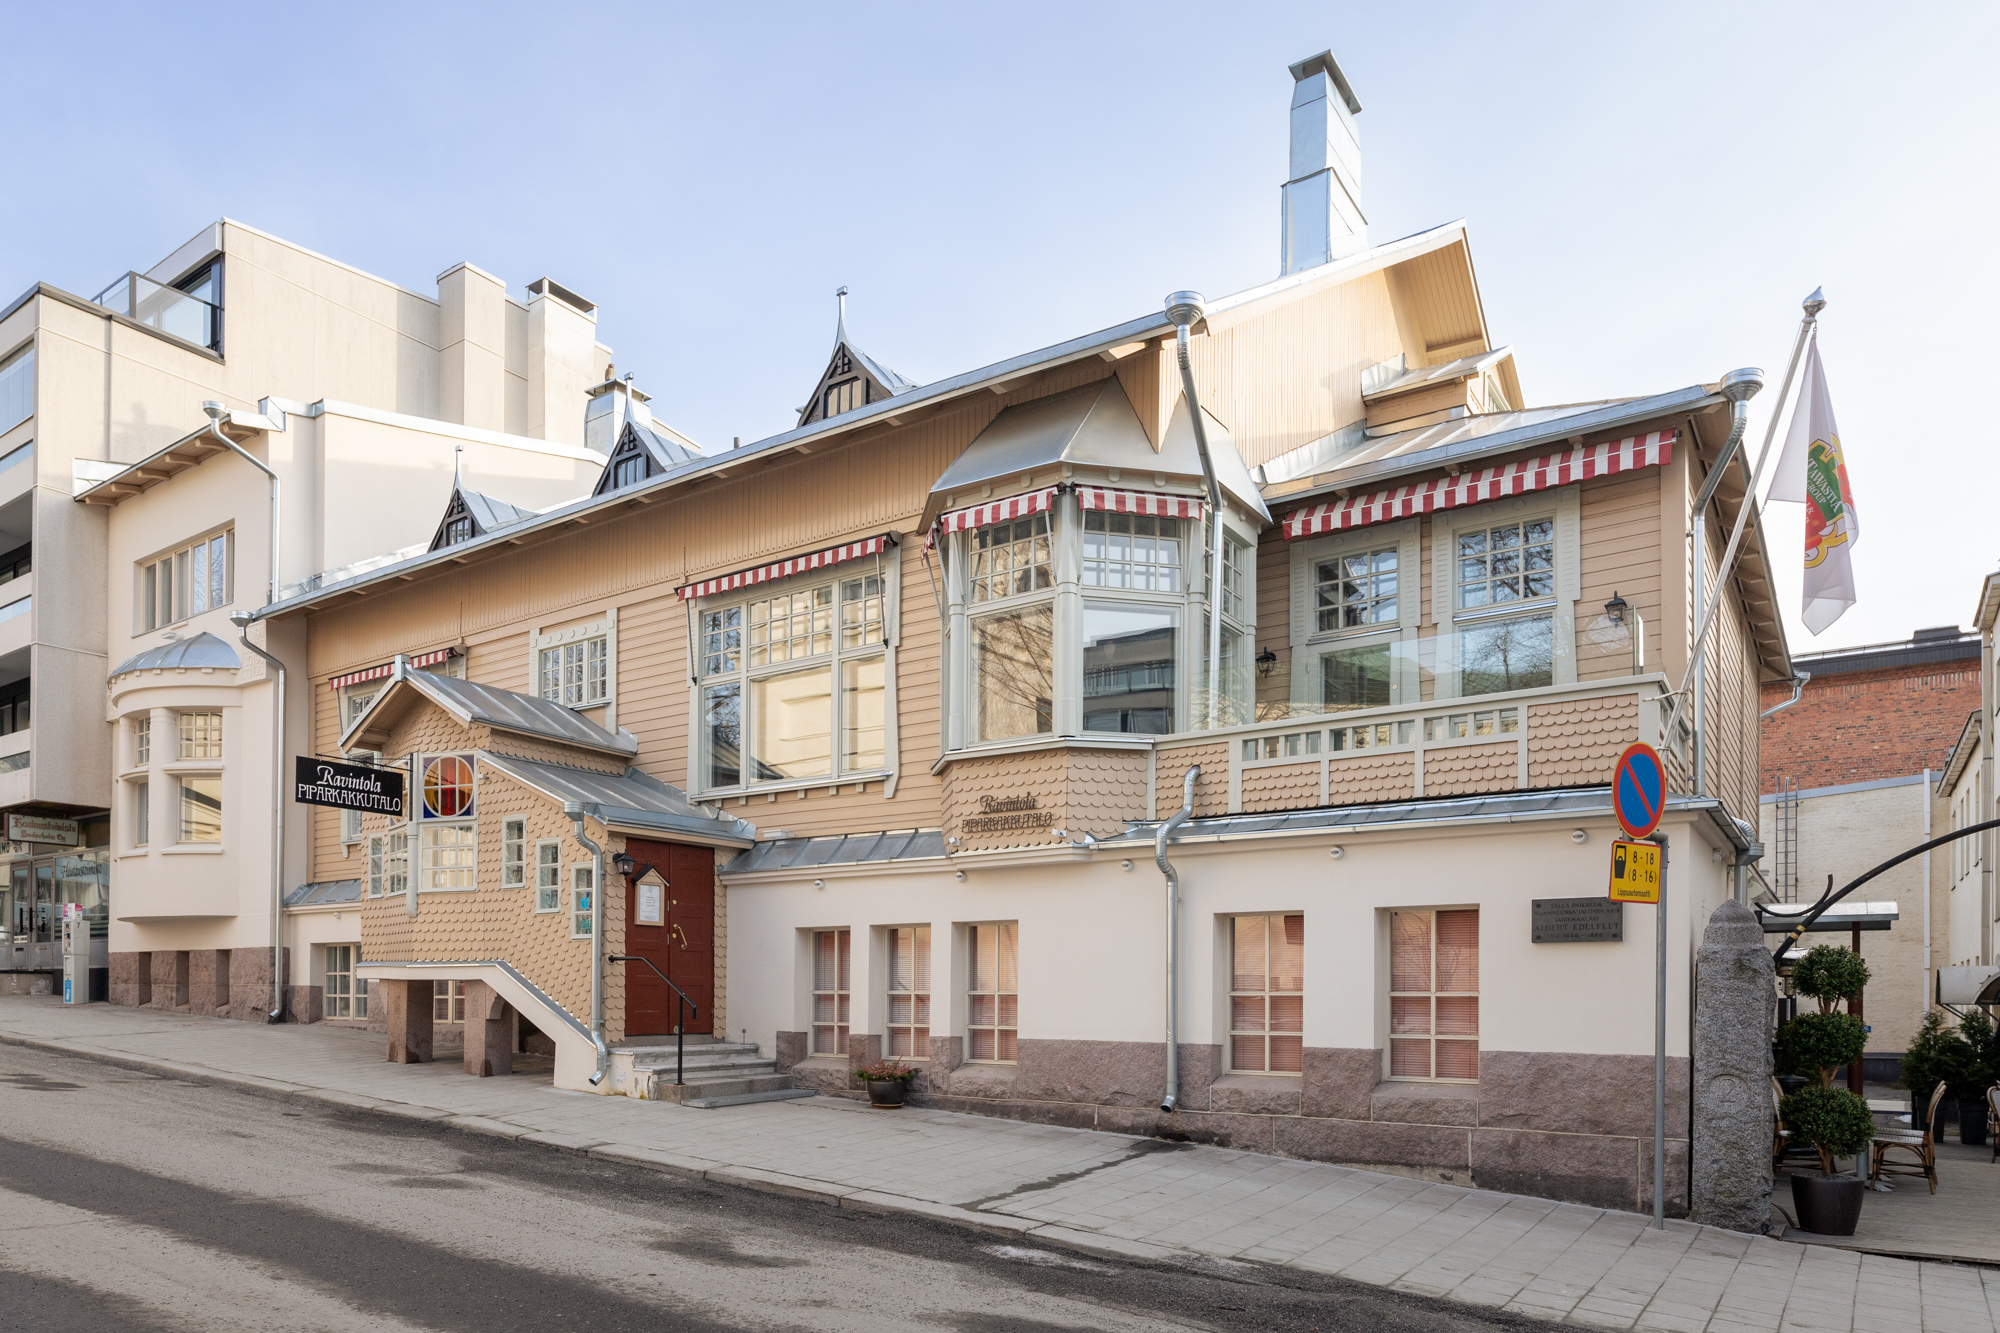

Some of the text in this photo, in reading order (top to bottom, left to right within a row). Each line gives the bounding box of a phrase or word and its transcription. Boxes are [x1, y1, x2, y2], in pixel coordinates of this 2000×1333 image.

[1807, 458, 1843, 513] TAWASTIA
[316, 765, 382, 793] Ravintola
[297, 783, 401, 812] PIPARKAKKUTALO
[978, 791, 1037, 815] Ravintola
[961, 811, 1054, 834] PIPARKAKKUTALO
[1632, 850, 1638, 864] 8
[1645, 852, 1655, 865] 18
[1628, 868, 1637, 883] (8
[1645, 869, 1657, 884] 16)
[1617, 887, 1651, 898] Lippuautomaatti
[1534, 922, 1620, 932] ALBERT EDELFELT
[1720, 1078, 1736, 1103] 2
